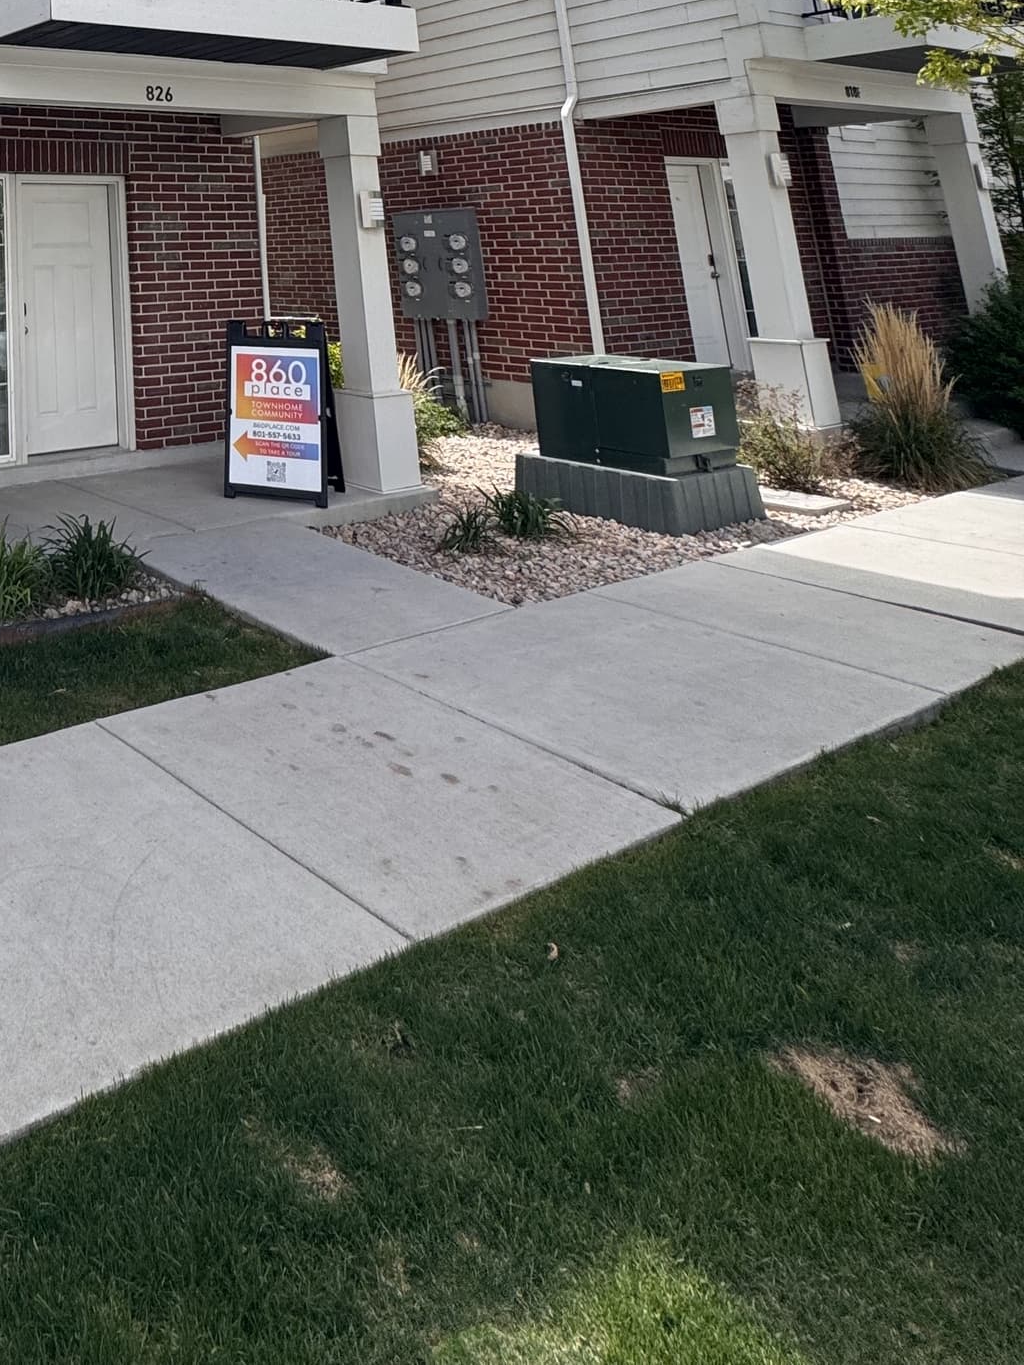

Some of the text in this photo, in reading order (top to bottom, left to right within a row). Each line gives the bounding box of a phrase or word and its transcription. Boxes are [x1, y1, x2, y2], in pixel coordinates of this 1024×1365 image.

[146, 85, 173, 102] 826
[251, 359, 307, 385] 860
[251, 383, 303, 397] place
[251, 401, 303, 411] TOWNHOME
[251, 409, 303, 419] COMMUNITY
